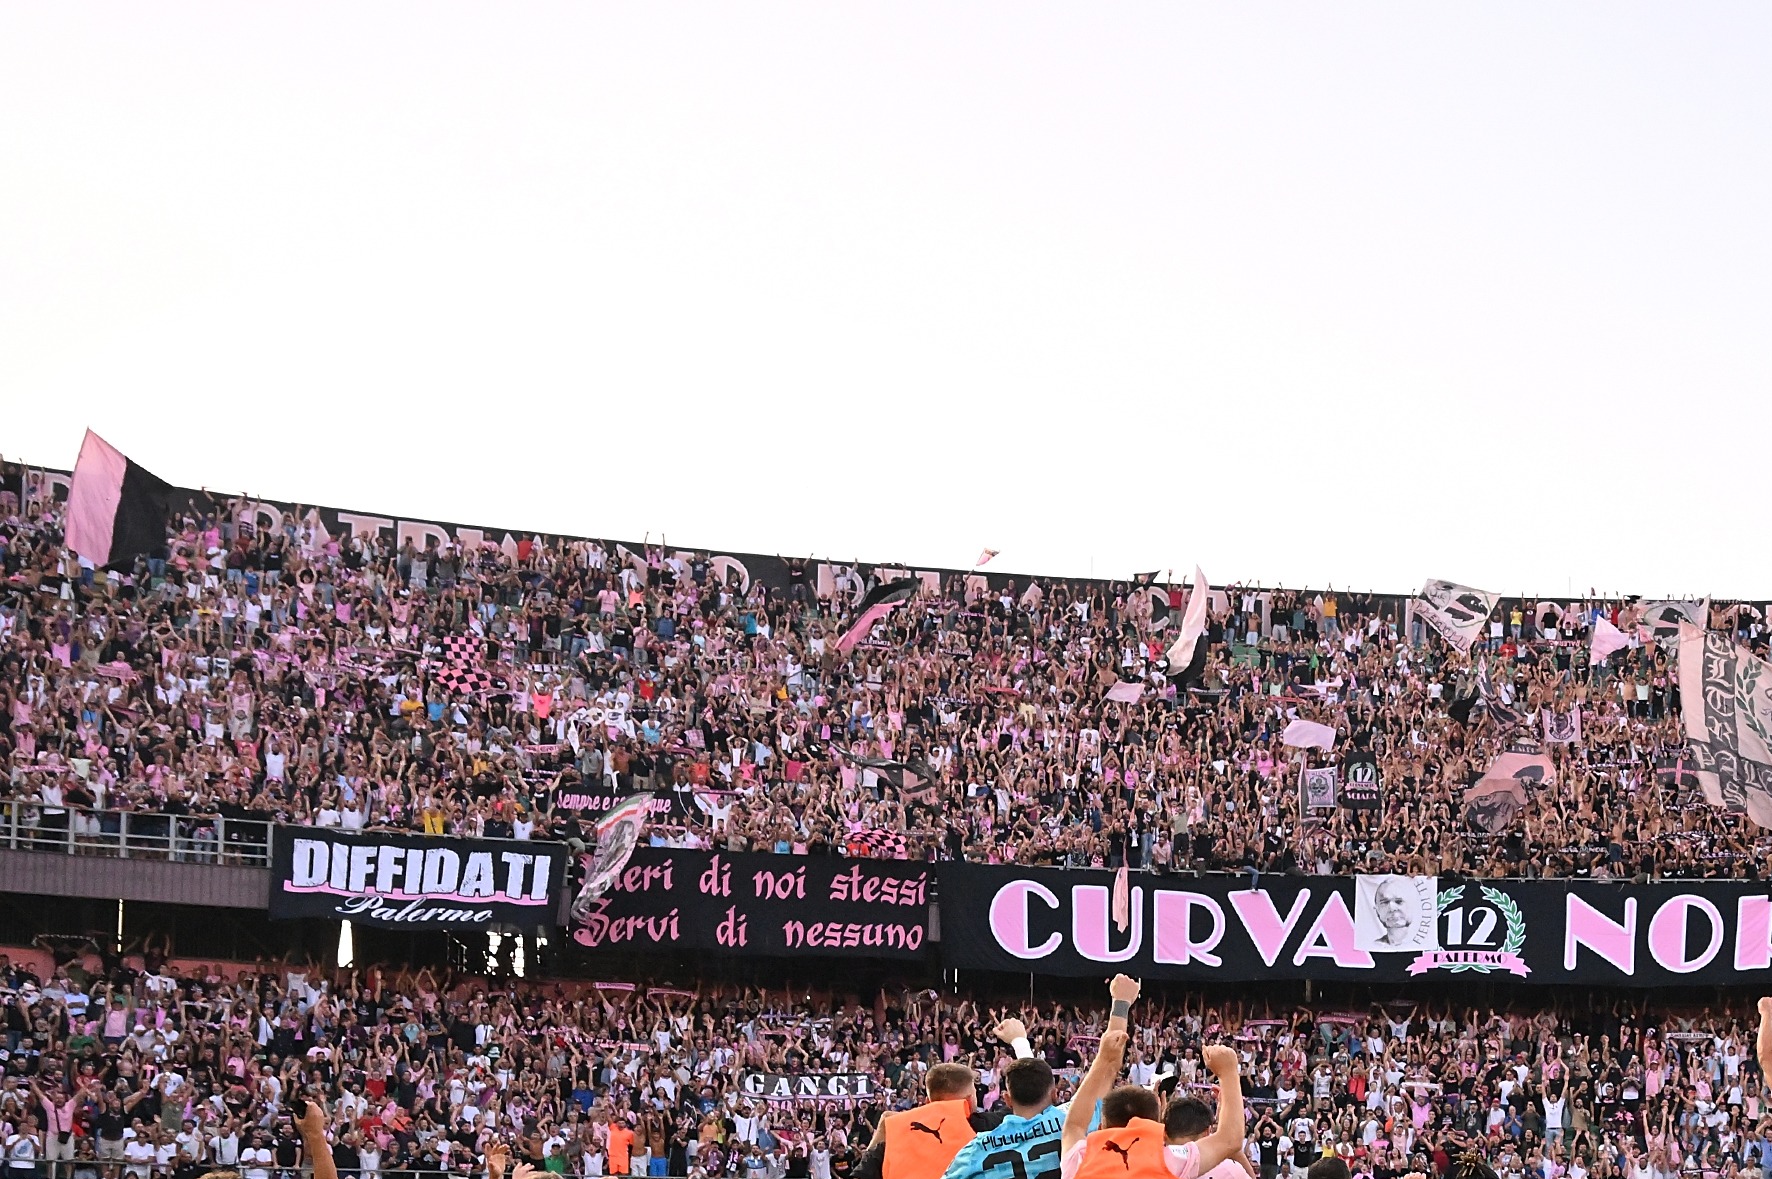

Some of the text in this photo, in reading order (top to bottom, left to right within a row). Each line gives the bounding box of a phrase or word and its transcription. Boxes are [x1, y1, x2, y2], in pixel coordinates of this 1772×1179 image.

[293, 838, 552, 901] DIFFIDATI
[699, 854, 731, 895] di
[754, 863, 806, 900] noi
[830, 871, 927, 907] stessi
[335, 893, 494, 923] Palermo
[716, 906, 748, 946] di
[783, 920, 924, 952] nessuno
[989, 880, 1376, 968] CURVA
[1442, 906, 1498, 947] 12
[1433, 951, 1508, 964] PALERMO
[745, 1074, 868, 1096] GANGI
